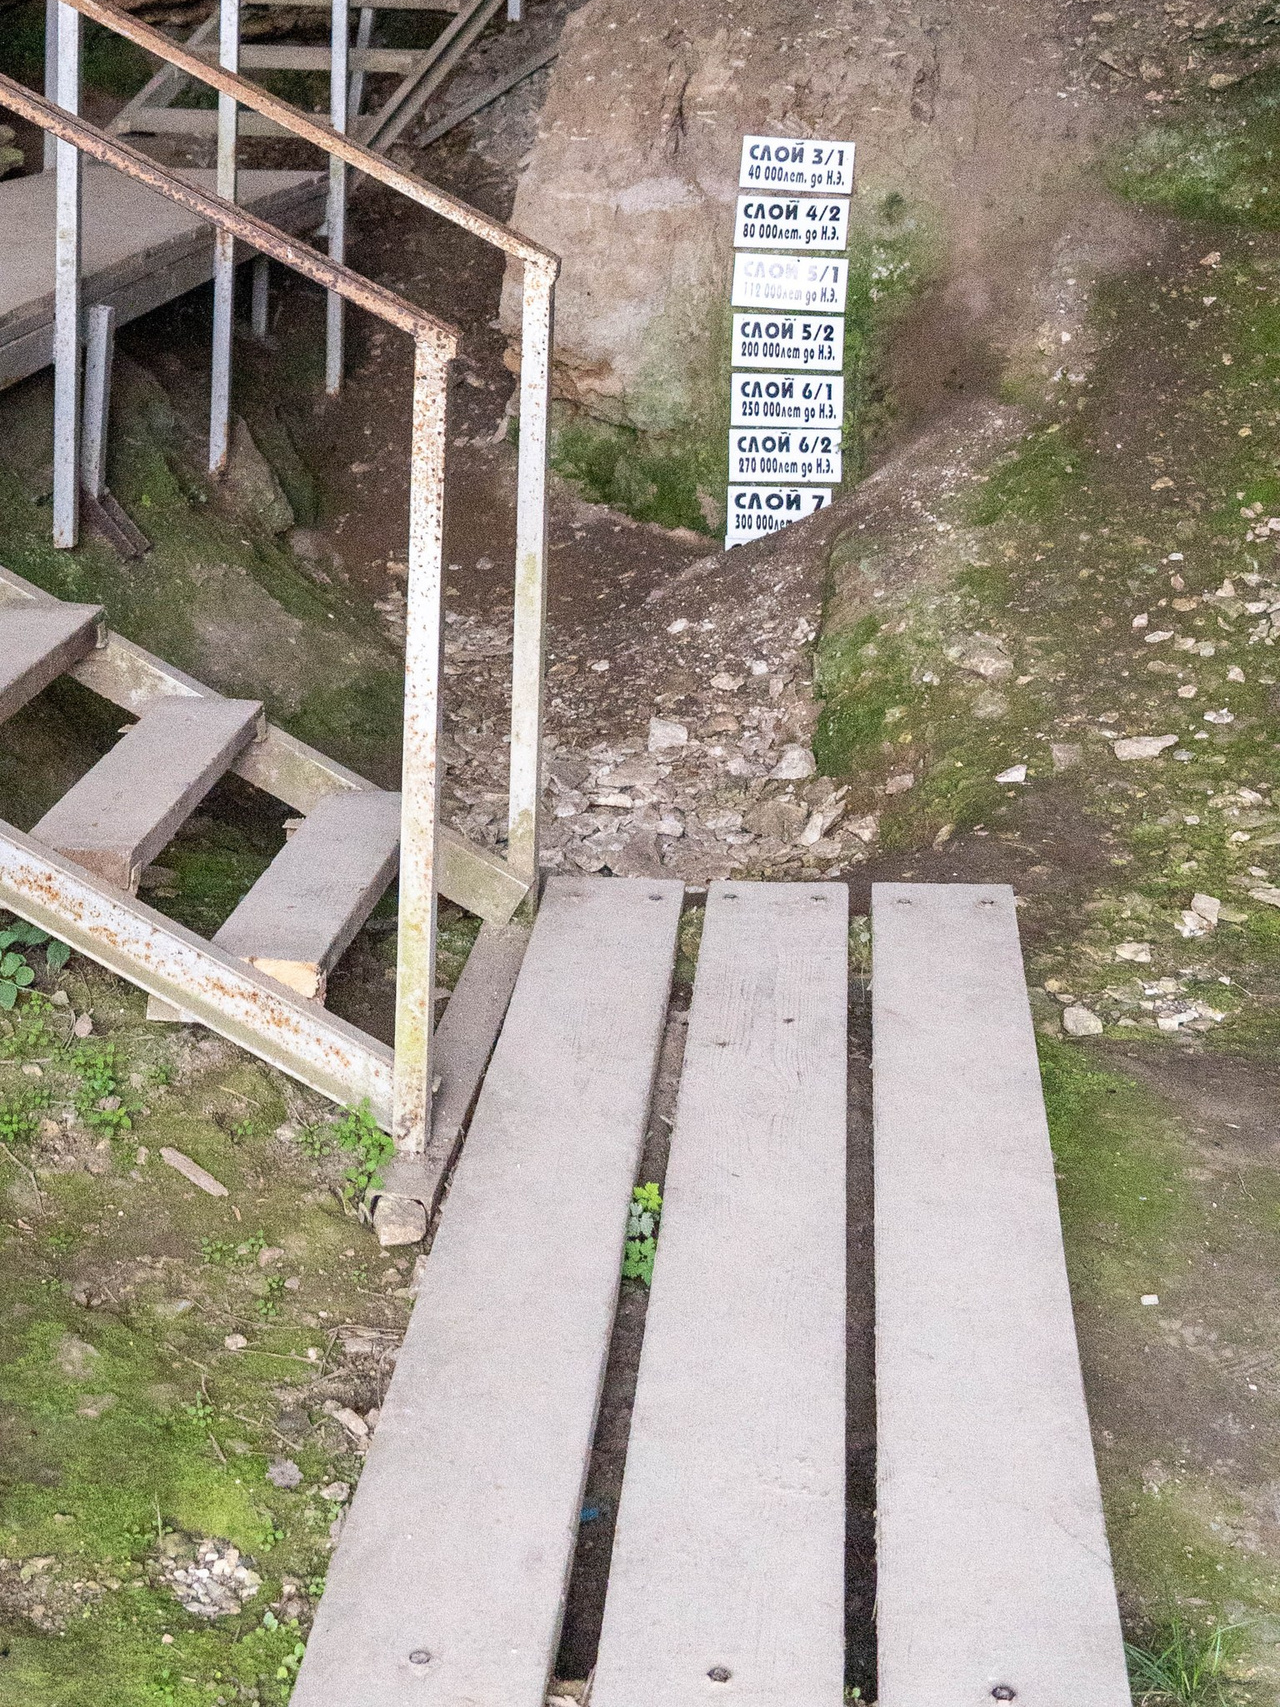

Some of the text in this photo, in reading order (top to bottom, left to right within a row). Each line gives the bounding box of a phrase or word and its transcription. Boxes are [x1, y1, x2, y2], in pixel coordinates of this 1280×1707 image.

[749, 142, 844, 166] СЛОЙ 3/1
[748, 166, 760, 179] 40
[811, 173, 822, 187] до
[827, 170, 844, 185] Н.Э.
[743, 200, 840, 221] СЛОЙ 4/2
[743, 224, 755, 237] 80
[805, 230, 817, 244] до
[821, 226, 839, 240] Н.Э.
[744, 260, 838, 283] СЛОЙ 5/1
[744, 282, 760, 297] 112
[805, 291, 817, 305] до
[741, 319, 834, 340] СЛОЙ 5/2
[741, 342, 759, 356] 200
[804, 349, 814, 363] до
[818, 346, 835, 360] Н.Э.
[741, 378, 832, 400] СЛОЙ 6/1
[742, 402, 759, 416] 250
[805, 408, 815, 422] до
[819, 405, 836, 419] Н.Э.
[737, 432, 832, 454] СЛОЙ 6/2
[739, 457, 756, 472] 270
[802, 463, 812, 477] до
[816, 459, 833, 474] Н.Э.
[735, 490, 801, 510] СЛОЙ
[735, 514, 752, 529] 300
